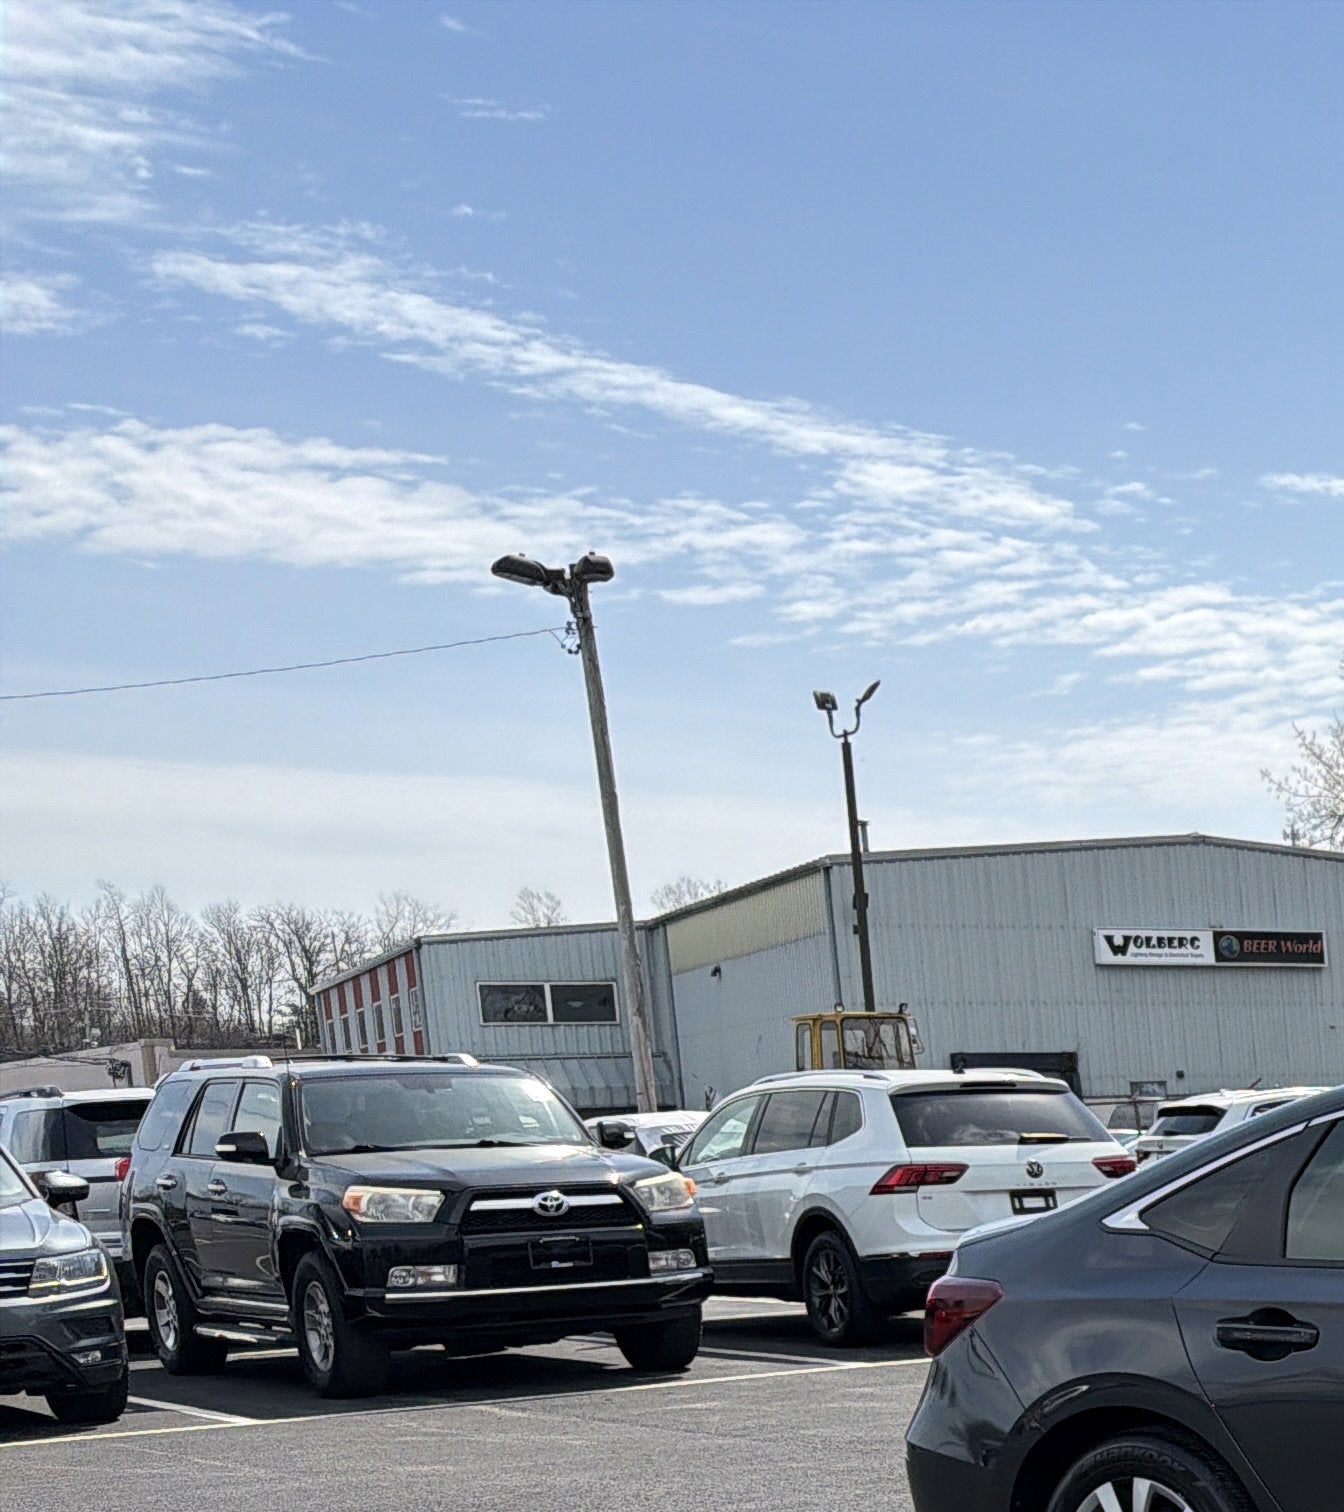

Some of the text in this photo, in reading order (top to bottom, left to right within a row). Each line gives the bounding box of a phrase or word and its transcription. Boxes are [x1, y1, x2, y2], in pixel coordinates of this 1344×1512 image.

[1103, 934, 1201, 956] WOLBERG
[1243, 939, 1323, 954] BEER World
